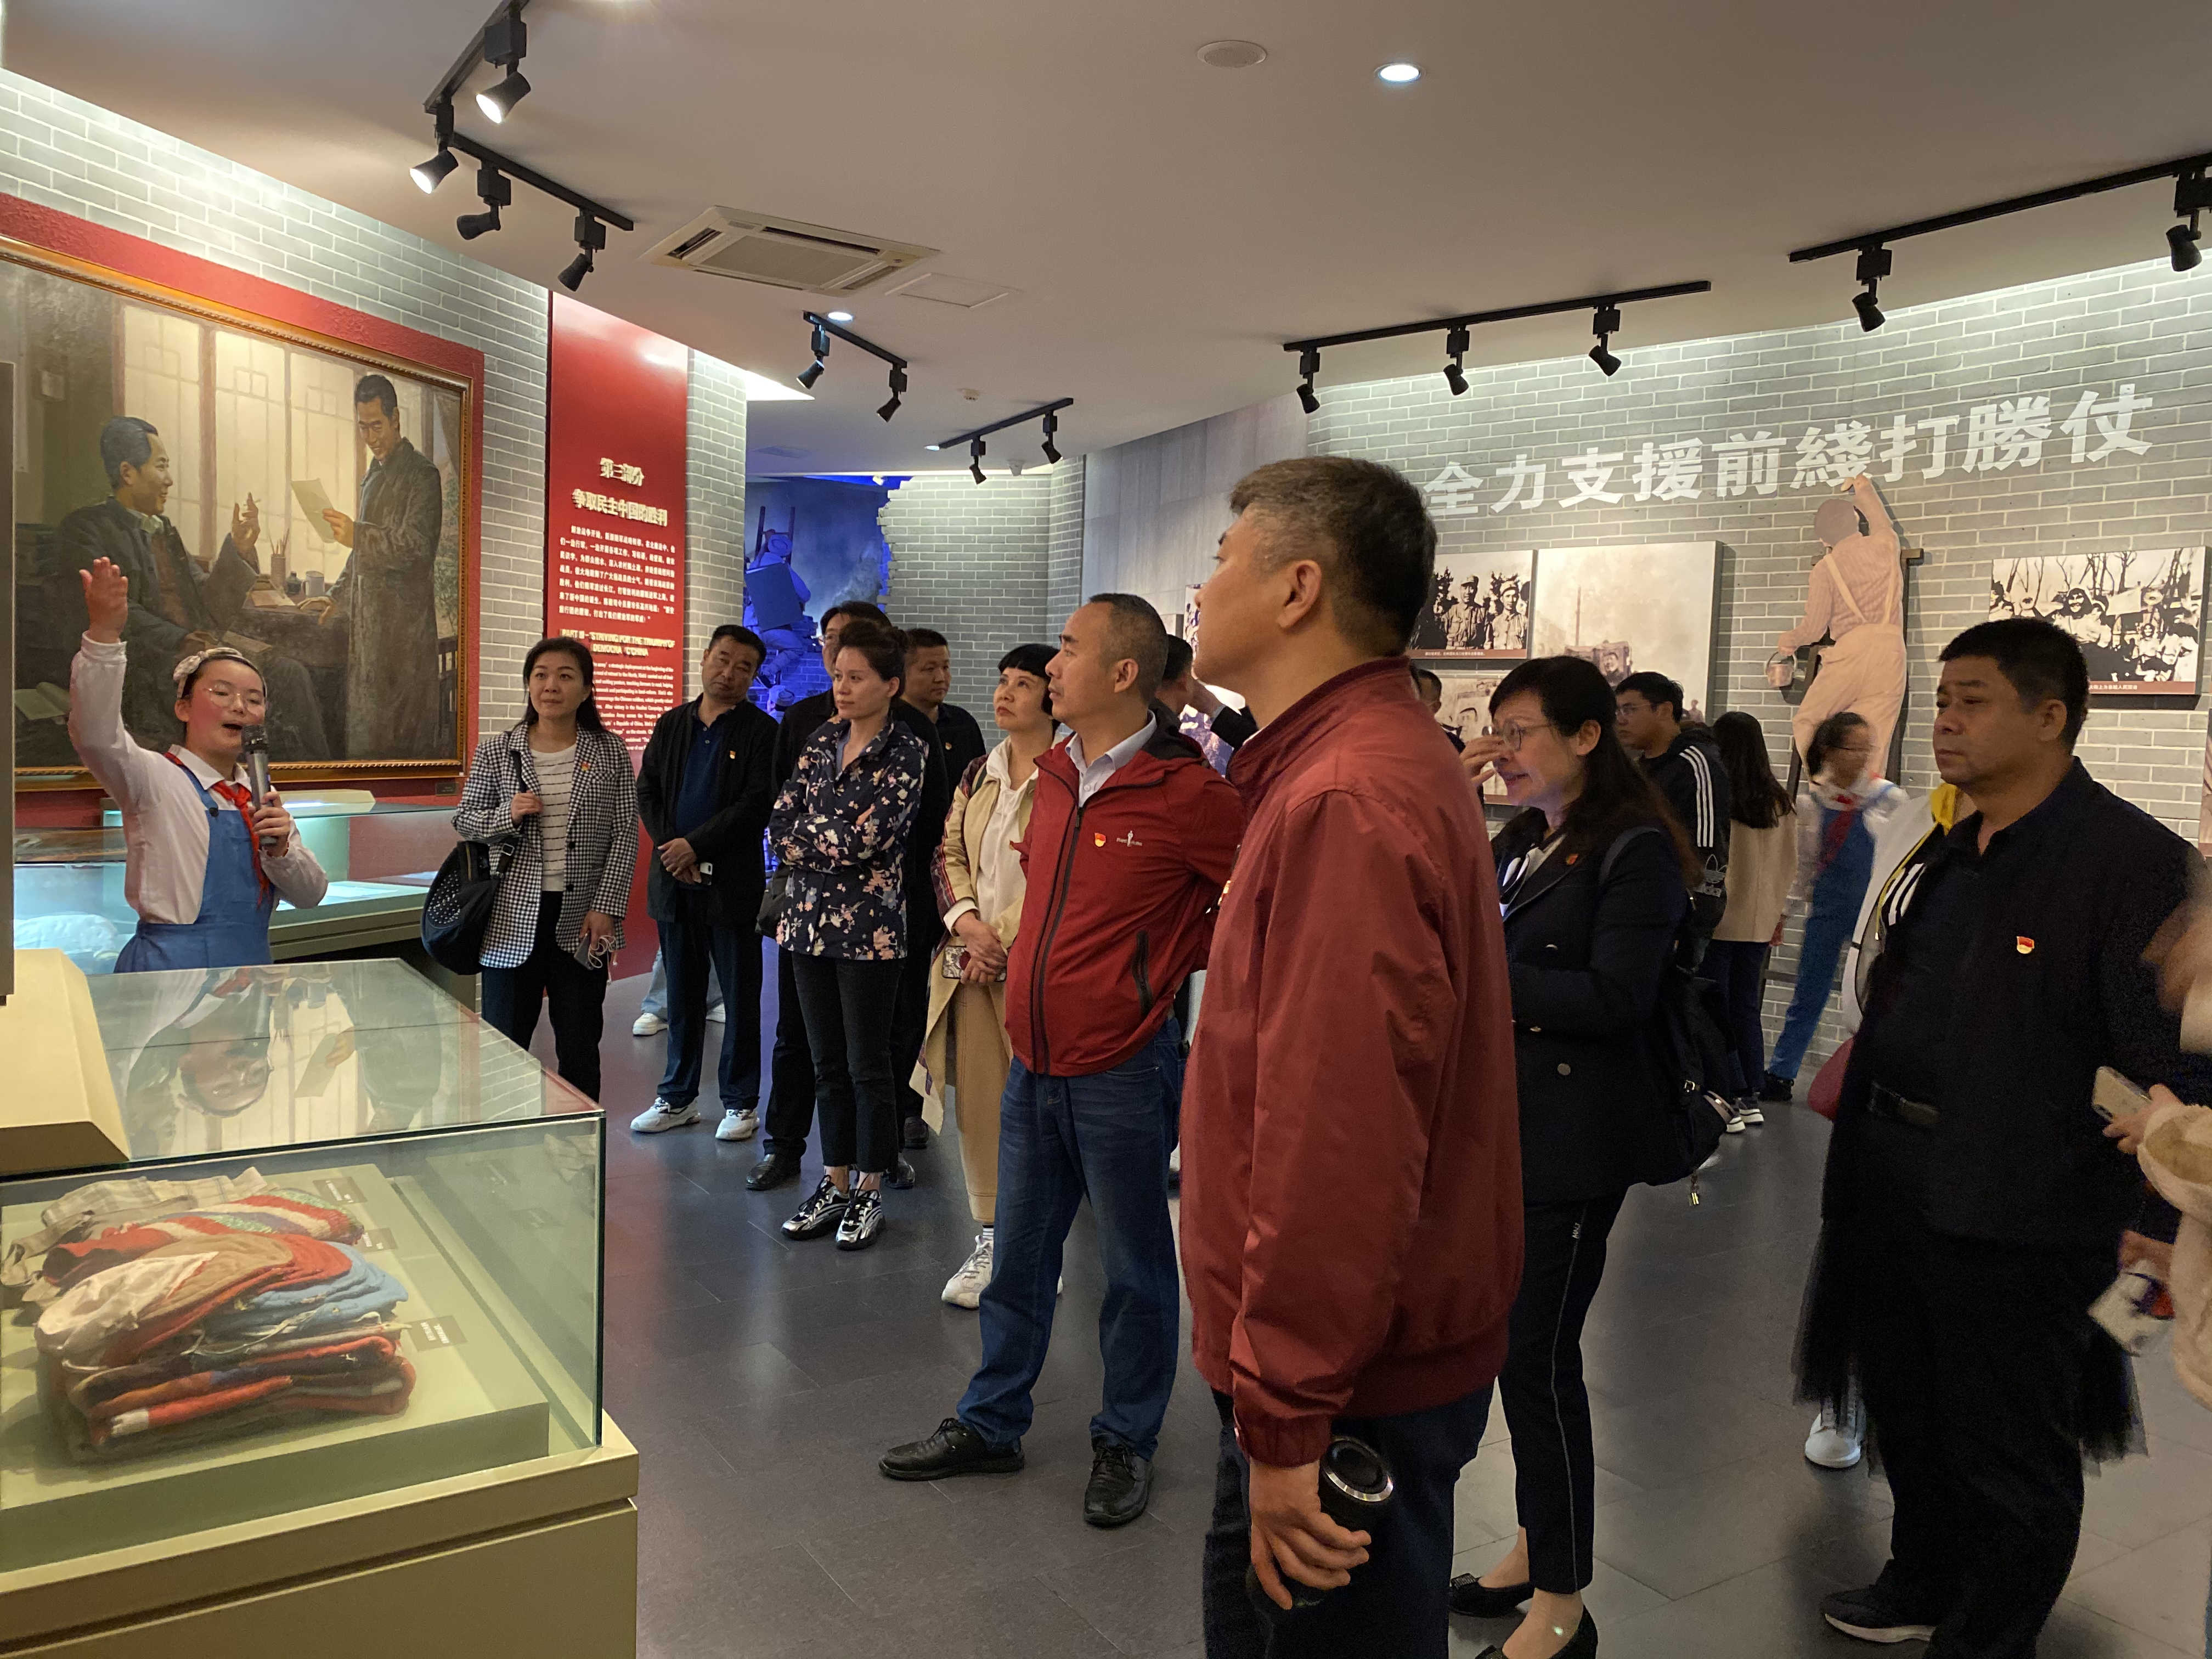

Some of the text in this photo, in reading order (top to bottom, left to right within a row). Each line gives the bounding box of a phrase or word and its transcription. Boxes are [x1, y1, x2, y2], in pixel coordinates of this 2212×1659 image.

[600, 458, 644, 486] 第三部分
[572, 489, 667, 527] 争取民主中国的胜利
